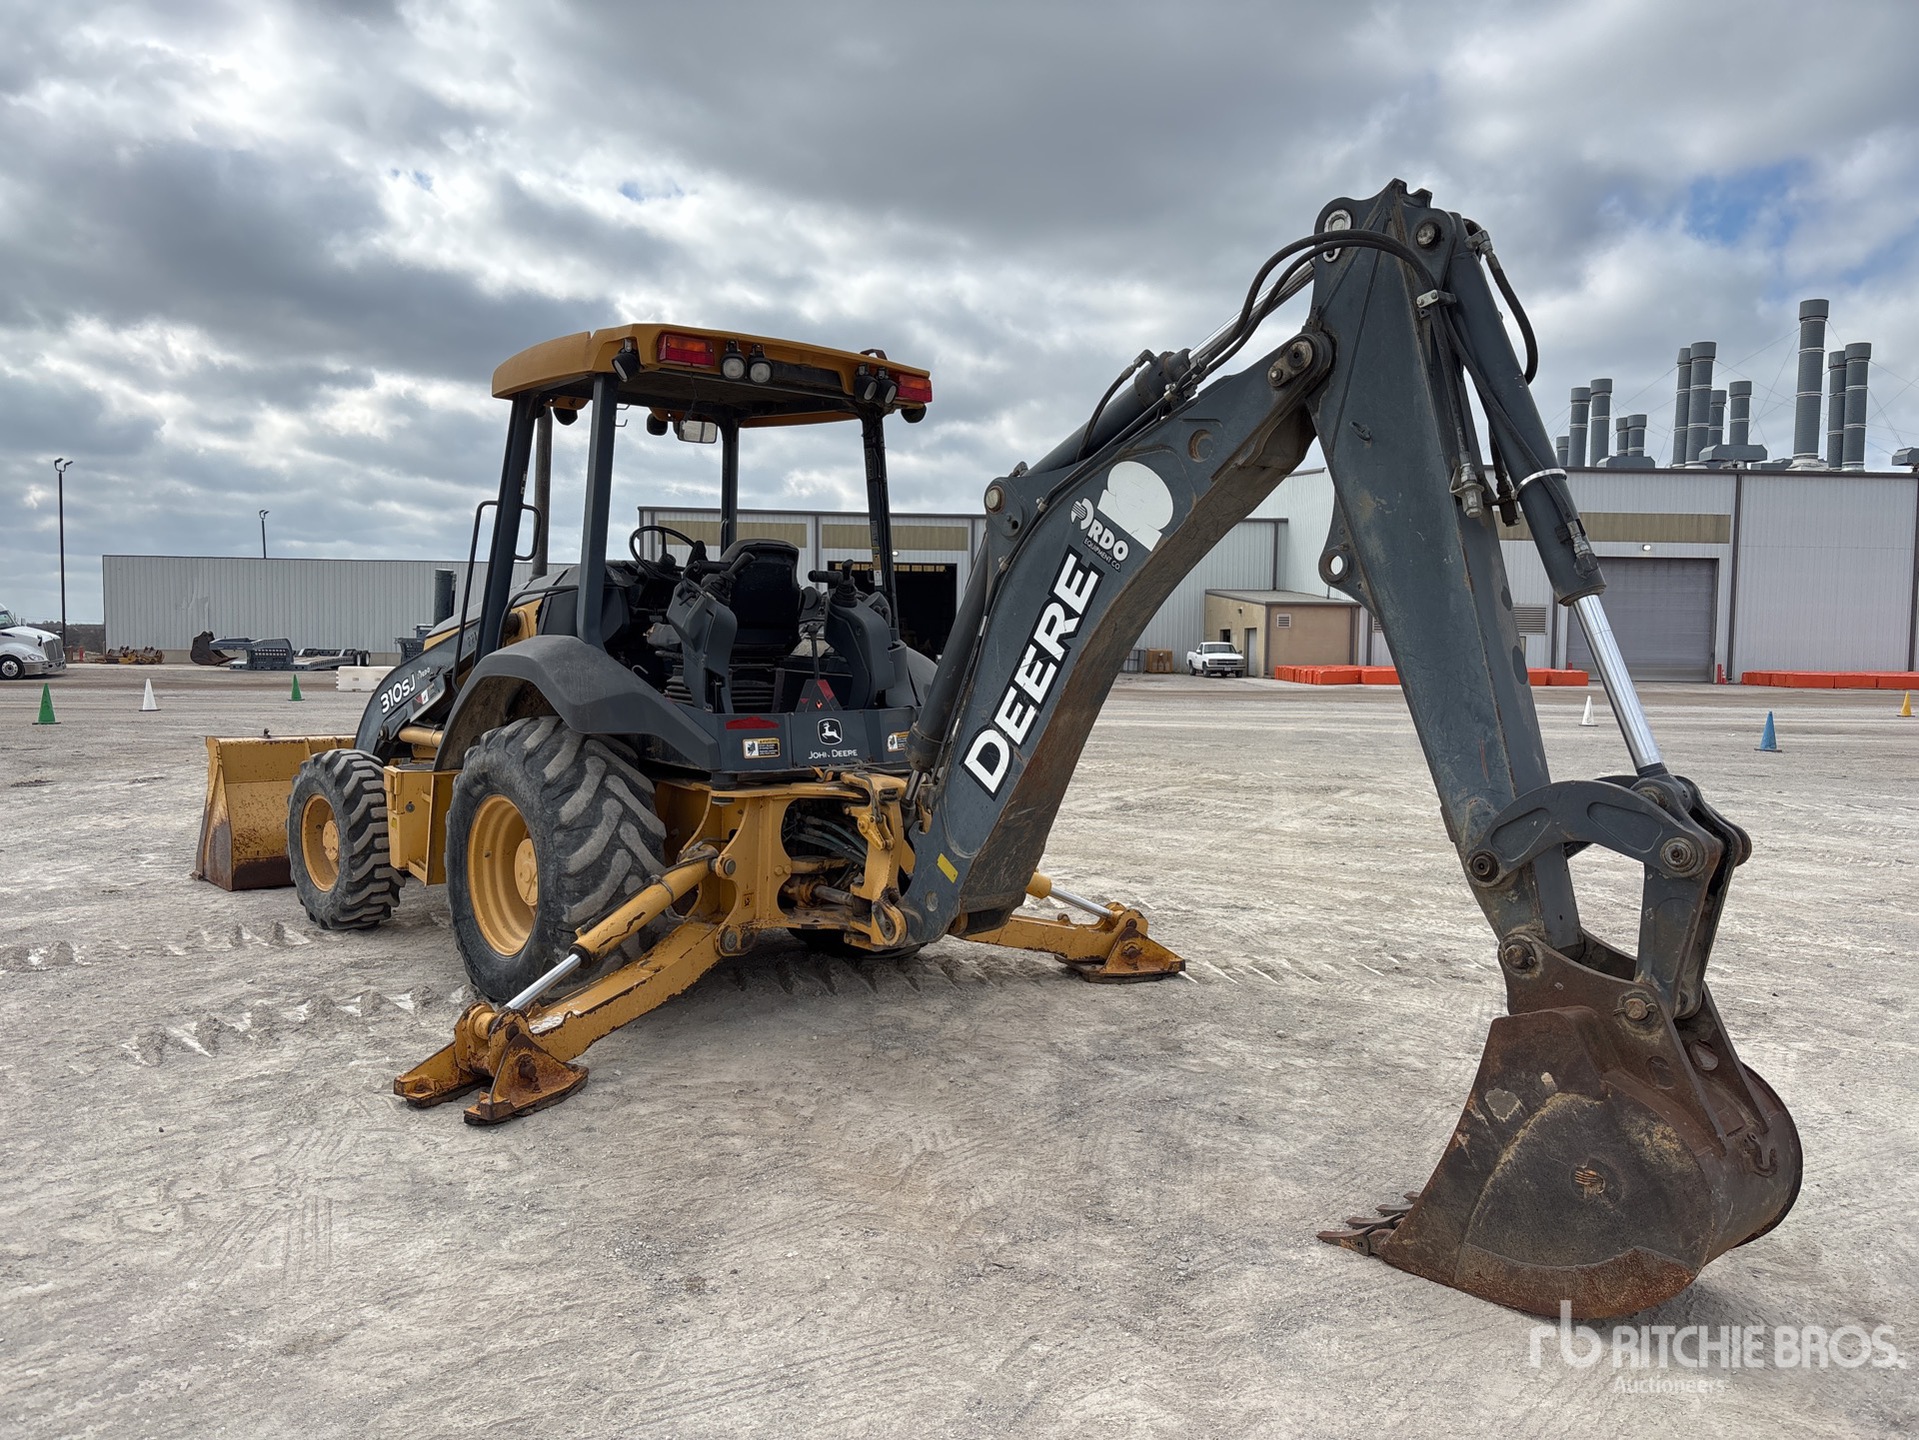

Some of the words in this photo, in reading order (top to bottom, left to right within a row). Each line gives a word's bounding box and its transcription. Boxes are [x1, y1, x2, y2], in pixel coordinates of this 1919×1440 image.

[380, 673, 416, 713] 310SJ
[963, 552, 1100, 794] DEERE
[831, 748, 858, 758] DEERE
